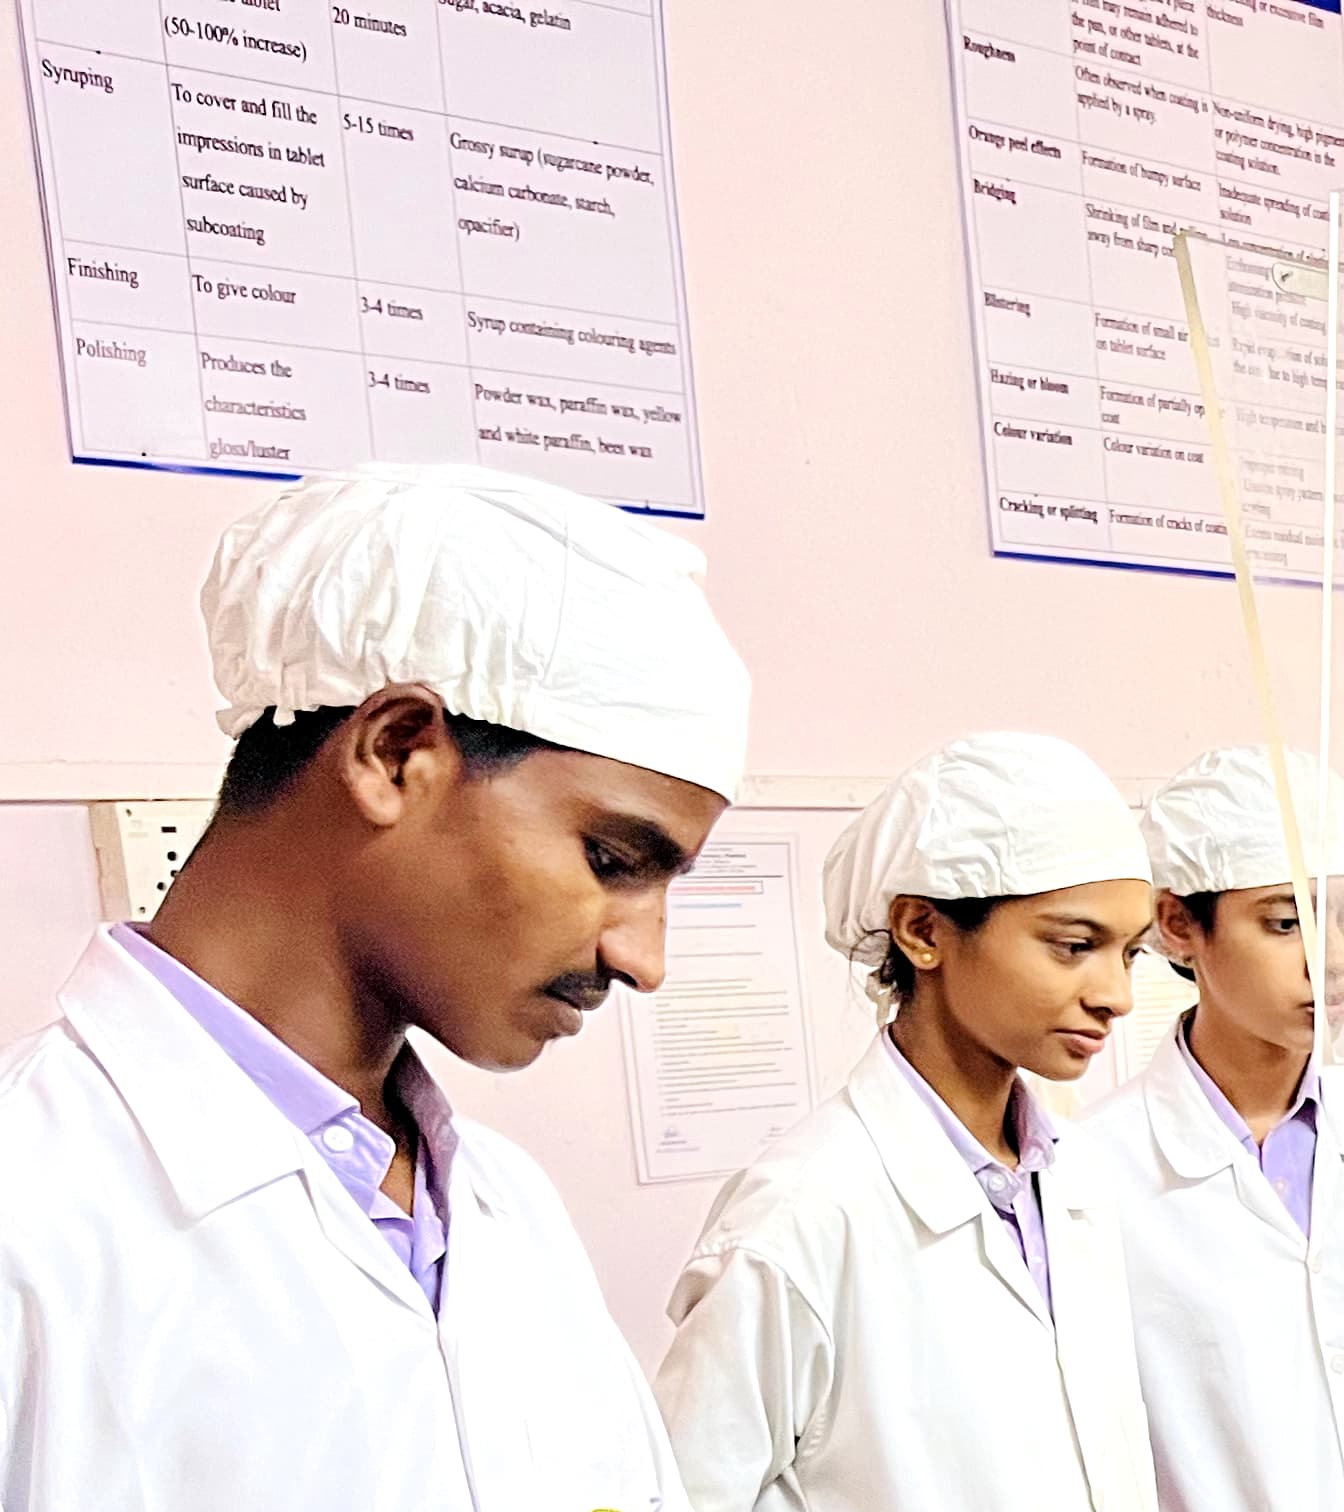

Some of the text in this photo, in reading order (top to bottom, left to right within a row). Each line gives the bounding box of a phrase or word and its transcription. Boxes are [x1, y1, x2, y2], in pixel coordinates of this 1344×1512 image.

[332, 6, 407, 37] 20 minutes
[482, 1, 526, 23] acacia,
[164, 16, 307, 62] (50-100% increase)
[41, 59, 114, 93] Syruping
[171, 82, 318, 125] To cover and fill the
[343, 113, 414, 142] 5-15 times
[969, 125, 1005, 149] Orange
[1008, 135, 1028, 152] peel
[176, 127, 325, 168] impressions in tablet
[1082, 151, 1127, 173] Formation
[182, 173, 308, 211] surface caused by
[454, 175, 505, 197] calcium
[974, 178, 1016, 205] Bridging
[187, 216, 266, 246] subcoating
[67, 257, 139, 289] Finishing
[192, 275, 296, 305] To give colour
[361, 296, 424, 321] 3-4 times
[467, 311, 506, 335] Syrup
[509, 320, 575, 345] containing
[577, 329, 636, 354] colouring
[76, 337, 147, 367] Polishing
[201, 352, 293, 378] Produces the
[368, 370, 431, 394] 3-4 times
[204, 395, 307, 421] characteristics
[474, 383, 523, 406] Powder
[560, 397, 608, 415] paraffin
[643, 406, 682, 425] yellow
[478, 427, 502, 442] and
[505, 428, 541, 446] white
[993, 421, 1073, 446] Colour variation
[1103, 437, 1134, 453] Colour
[1136, 444, 1172, 459] variation
[1000, 496, 1045, 518] Cracking
